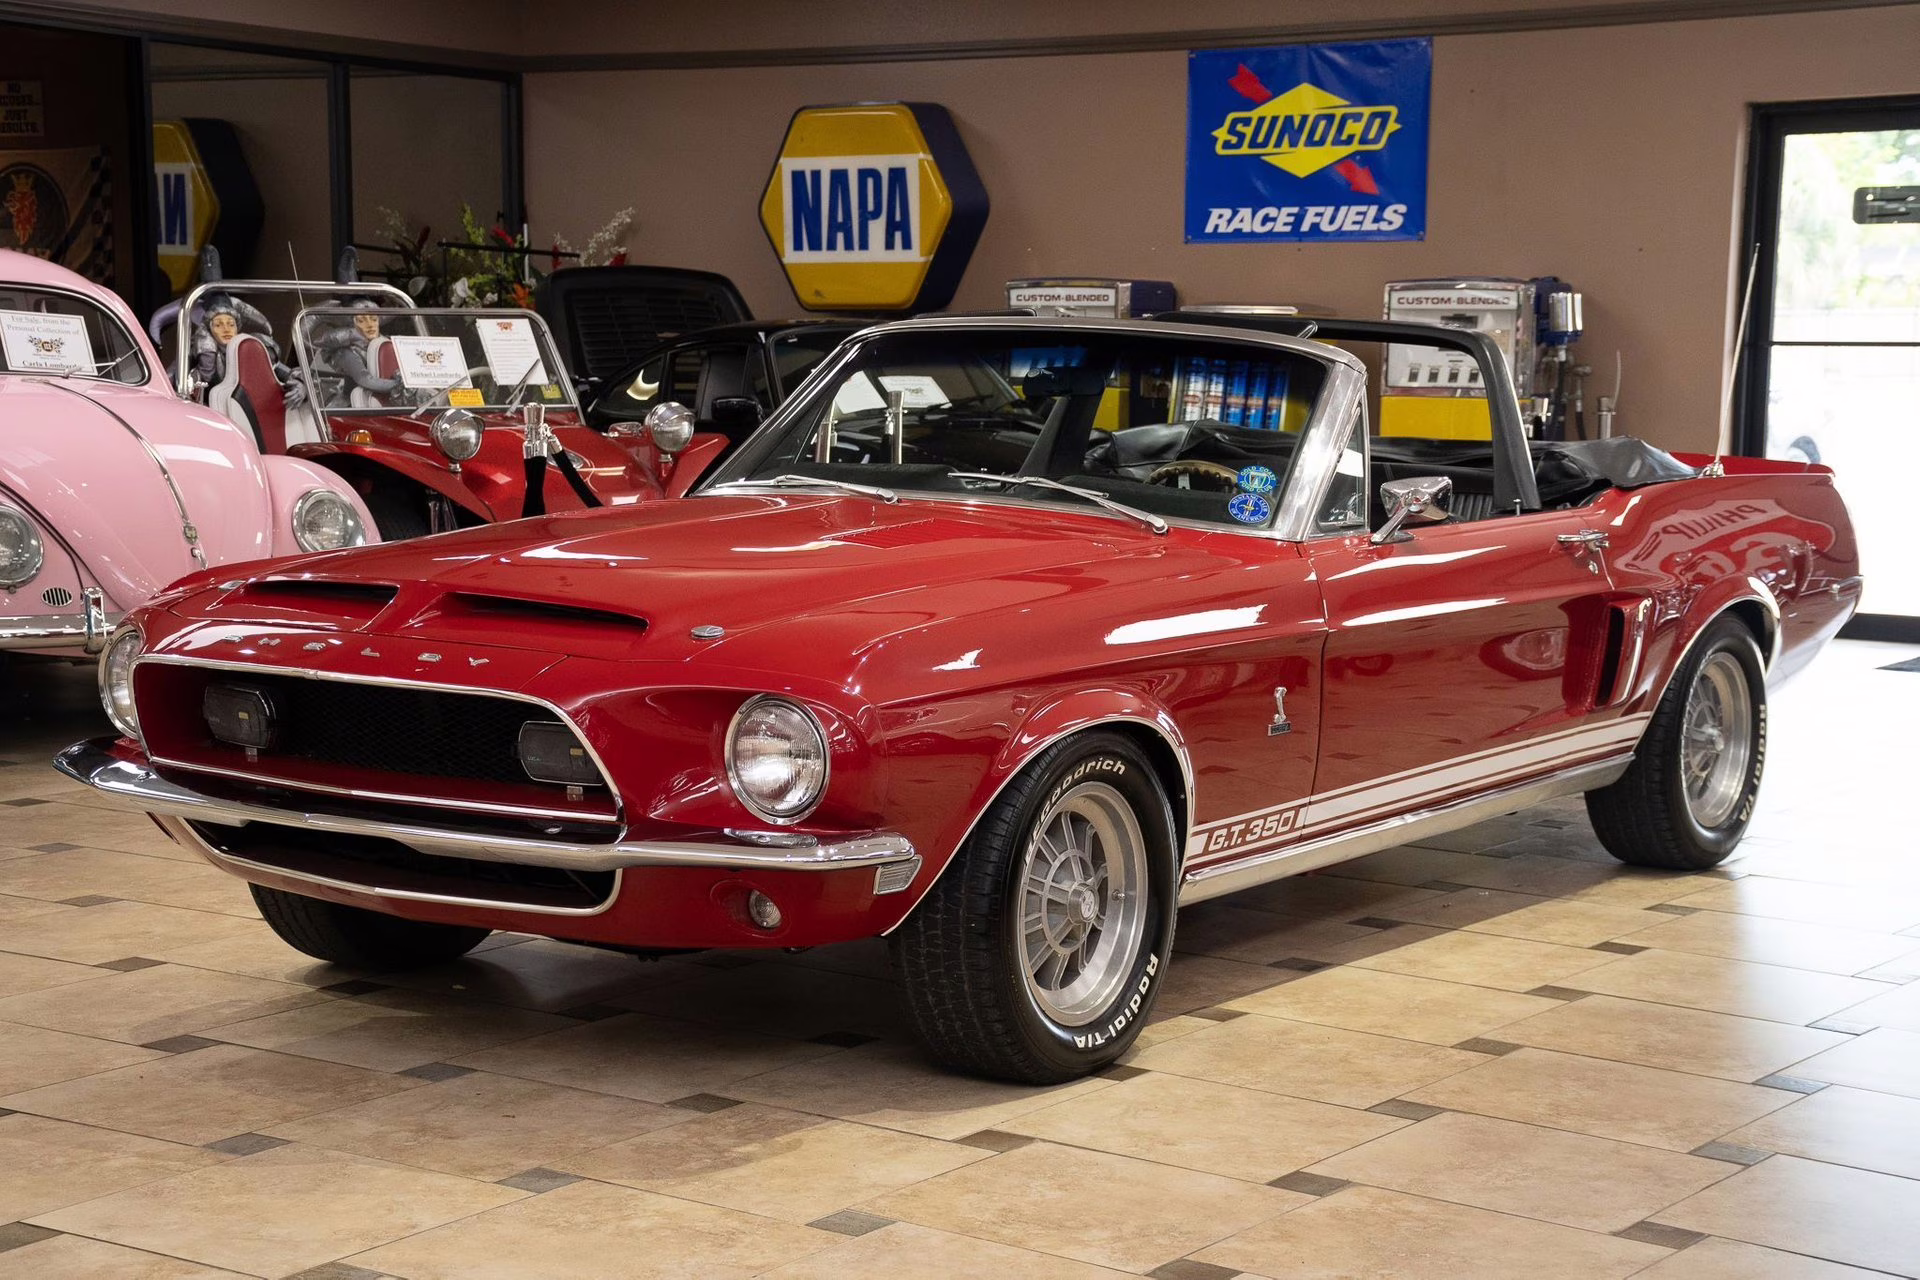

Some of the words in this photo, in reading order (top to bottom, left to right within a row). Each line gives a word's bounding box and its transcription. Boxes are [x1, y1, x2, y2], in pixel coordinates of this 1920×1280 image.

[1221, 111, 1392, 150] SUNOCO
[791, 167, 913, 252] NAPA
[1204, 206, 1300, 234] RACE
[1300, 203, 1408, 233] FUELS
[222, 634, 490, 666] SHELBY
[1753, 704, 1767, 786] Radial
[1108, 953, 1159, 1038] Radial
[1073, 1032, 1106, 1048] T/A
